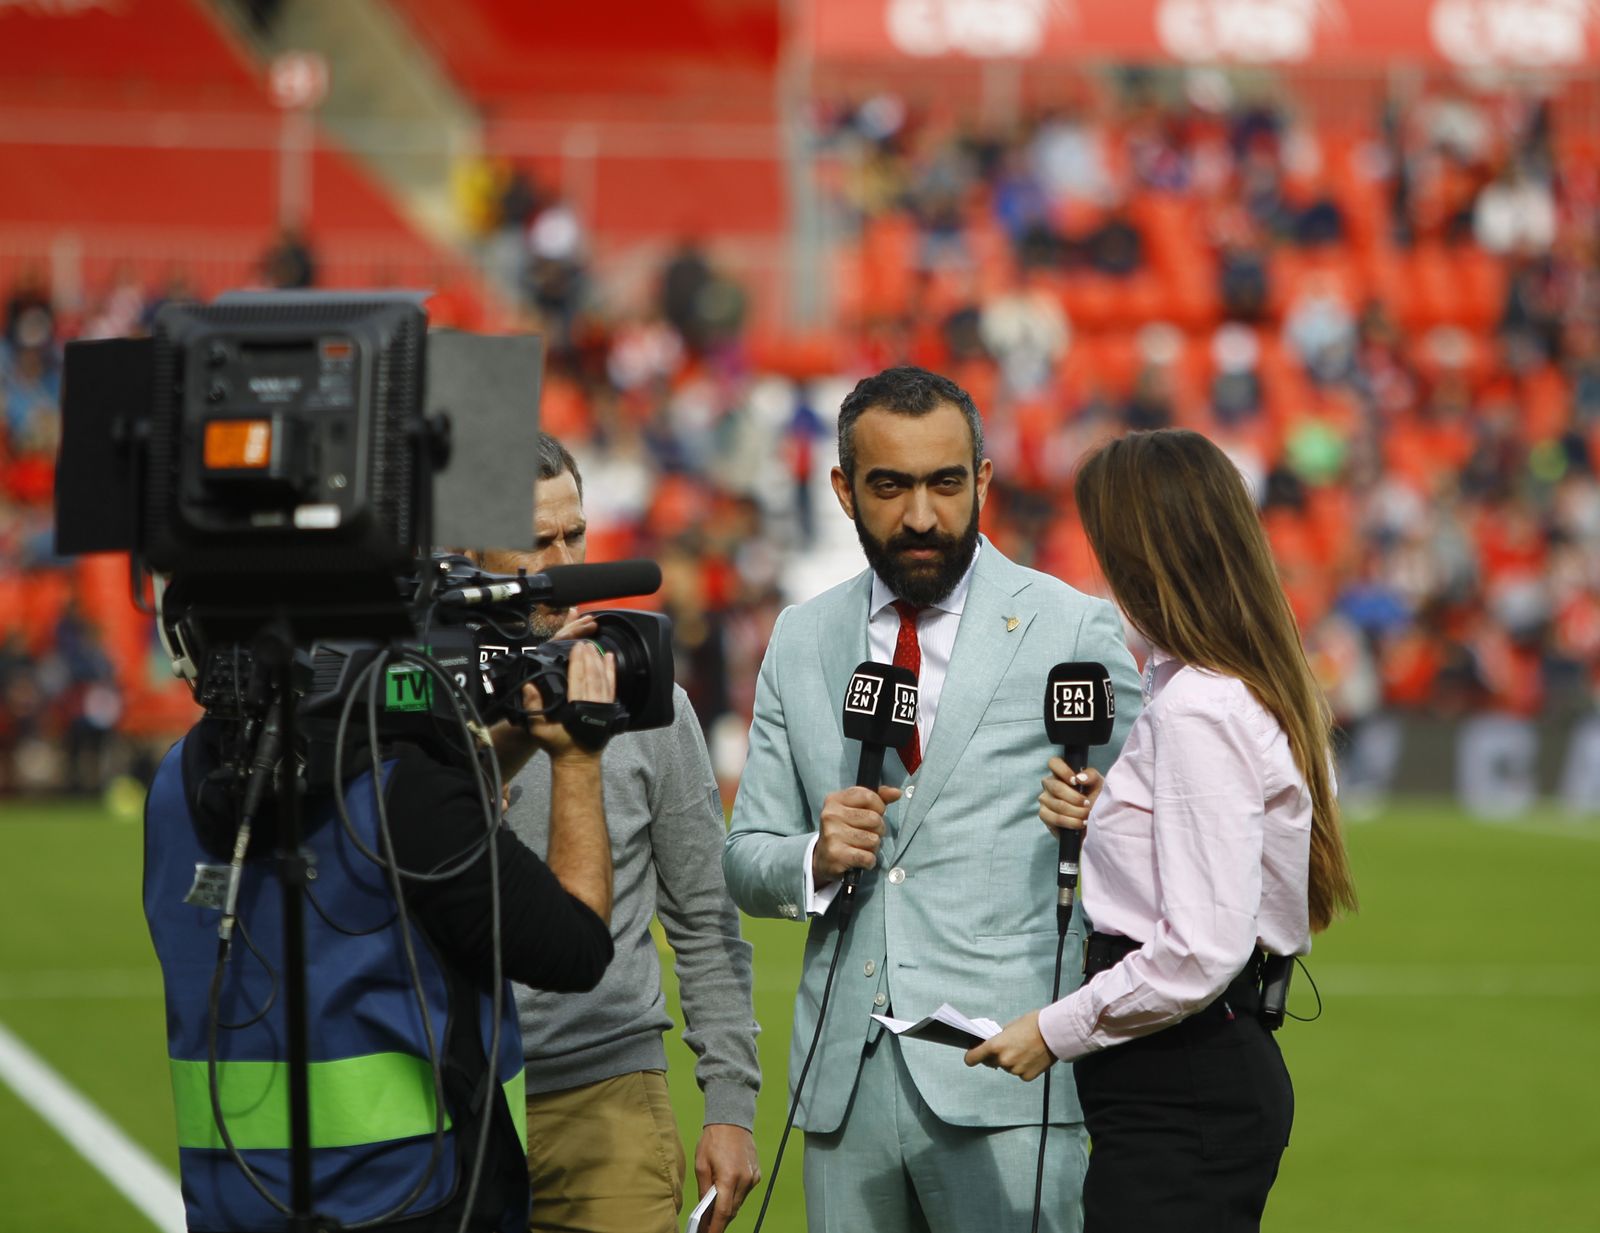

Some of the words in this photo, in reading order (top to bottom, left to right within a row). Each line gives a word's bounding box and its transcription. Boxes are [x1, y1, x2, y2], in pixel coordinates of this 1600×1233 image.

[392, 673, 426, 702] TV
[854, 679, 872, 694] DA
[1063, 687, 1085, 701] DA
[851, 693, 870, 708] ZN
[902, 690, 916, 705] DA
[899, 704, 915, 719] ZN
[1063, 702, 1084, 715] ZN
